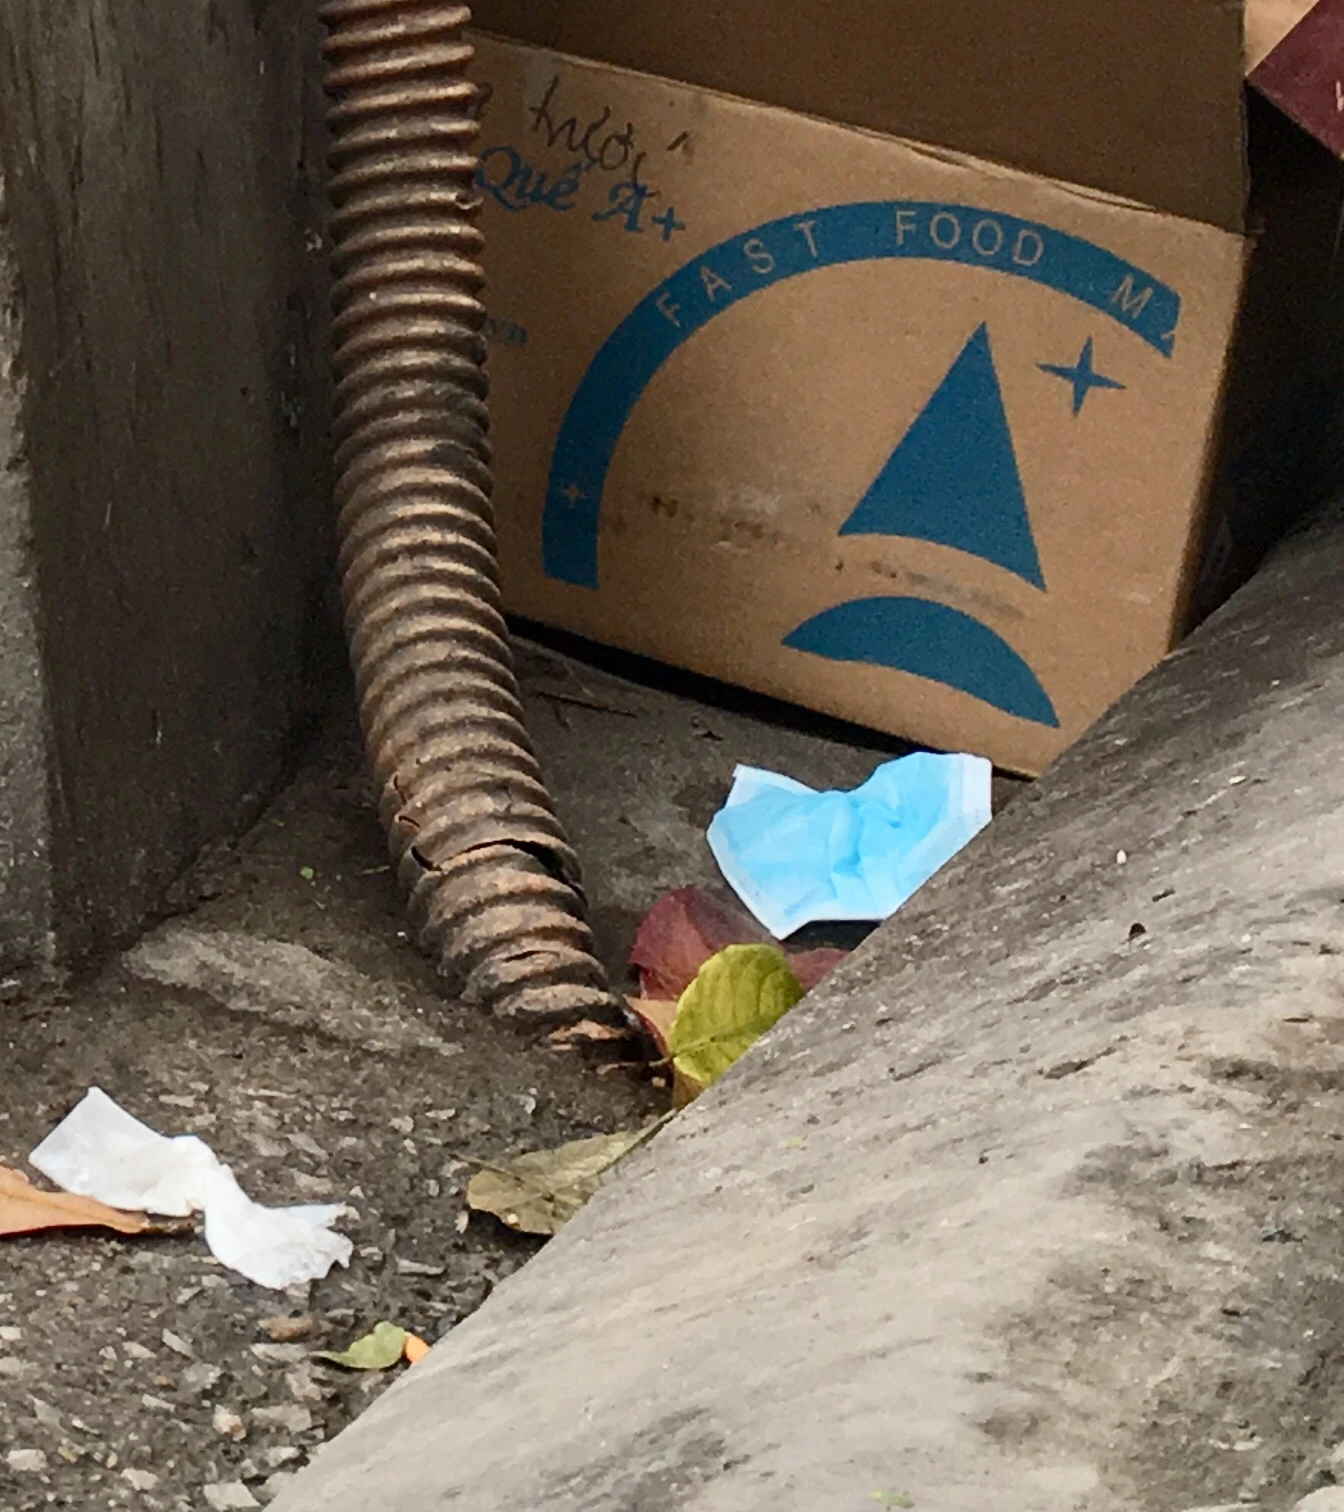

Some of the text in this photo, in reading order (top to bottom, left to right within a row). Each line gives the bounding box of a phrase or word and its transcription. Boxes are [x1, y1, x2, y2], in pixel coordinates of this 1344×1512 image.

[654, 209, 1164, 329] FAST FOOD M
